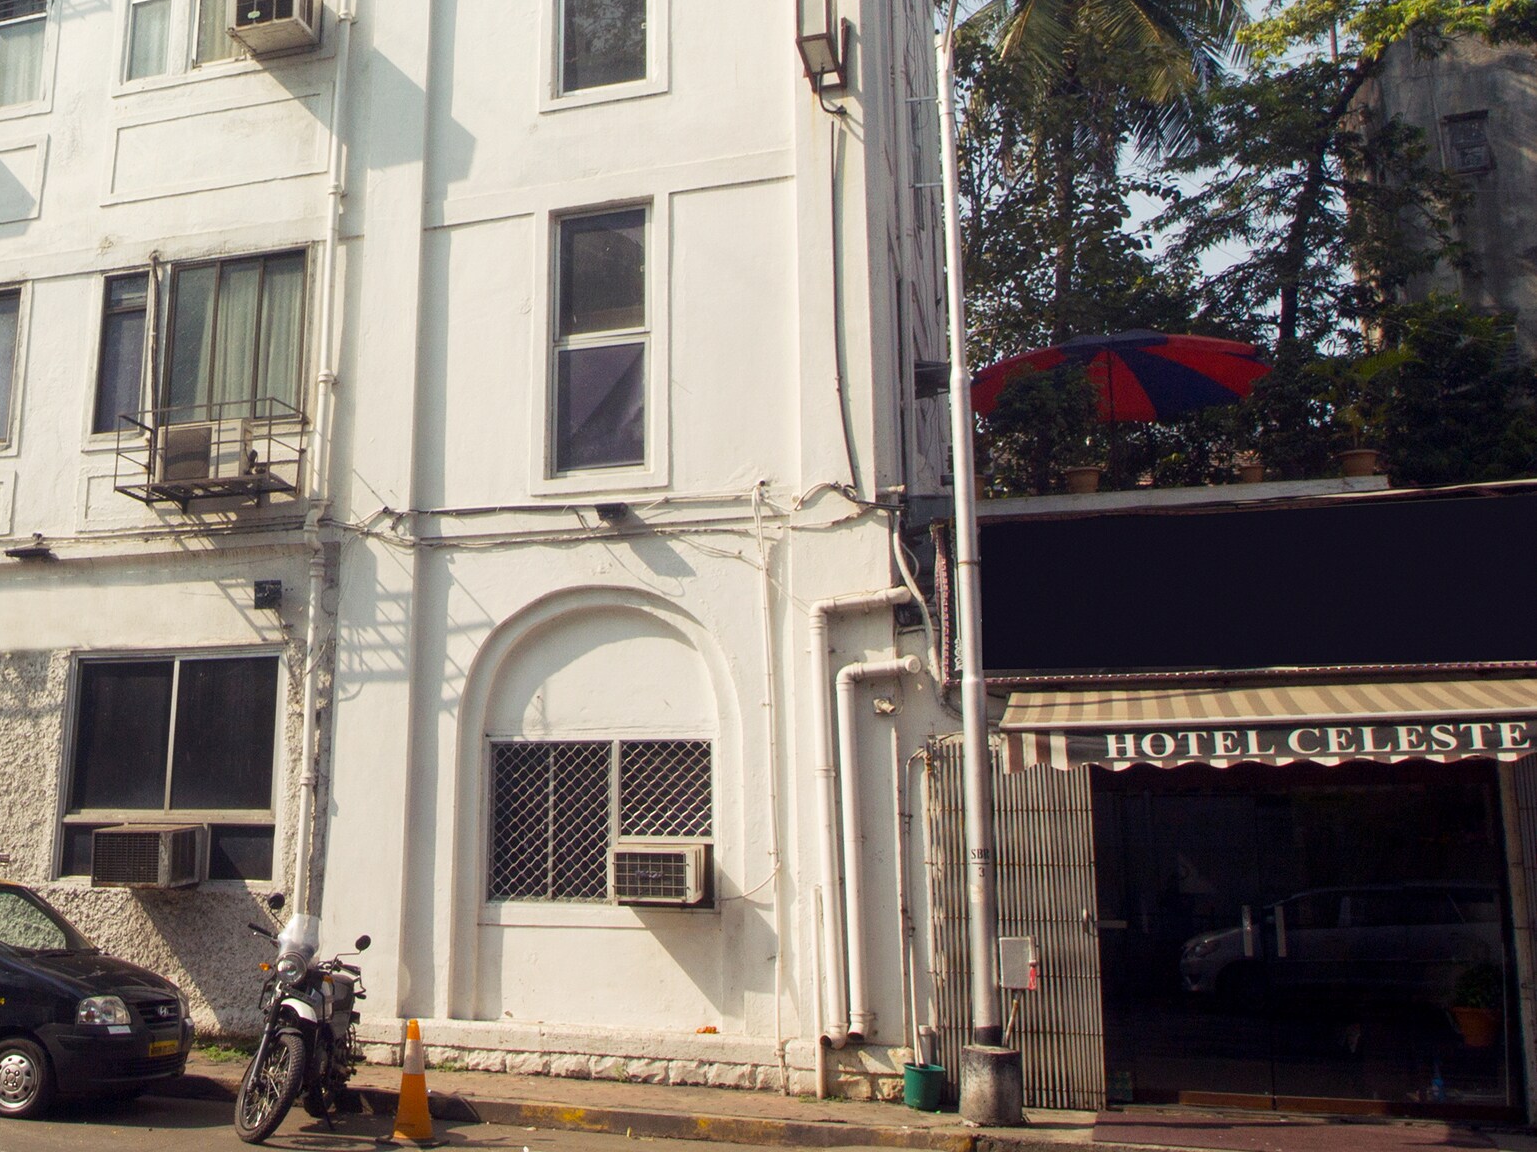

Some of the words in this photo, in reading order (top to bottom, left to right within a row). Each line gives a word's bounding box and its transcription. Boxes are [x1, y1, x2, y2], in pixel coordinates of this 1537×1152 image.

[1105, 730, 1275, 758] HOTEL
[1288, 721, 1531, 754] CELESTE
[978, 867, 985, 877] 3
